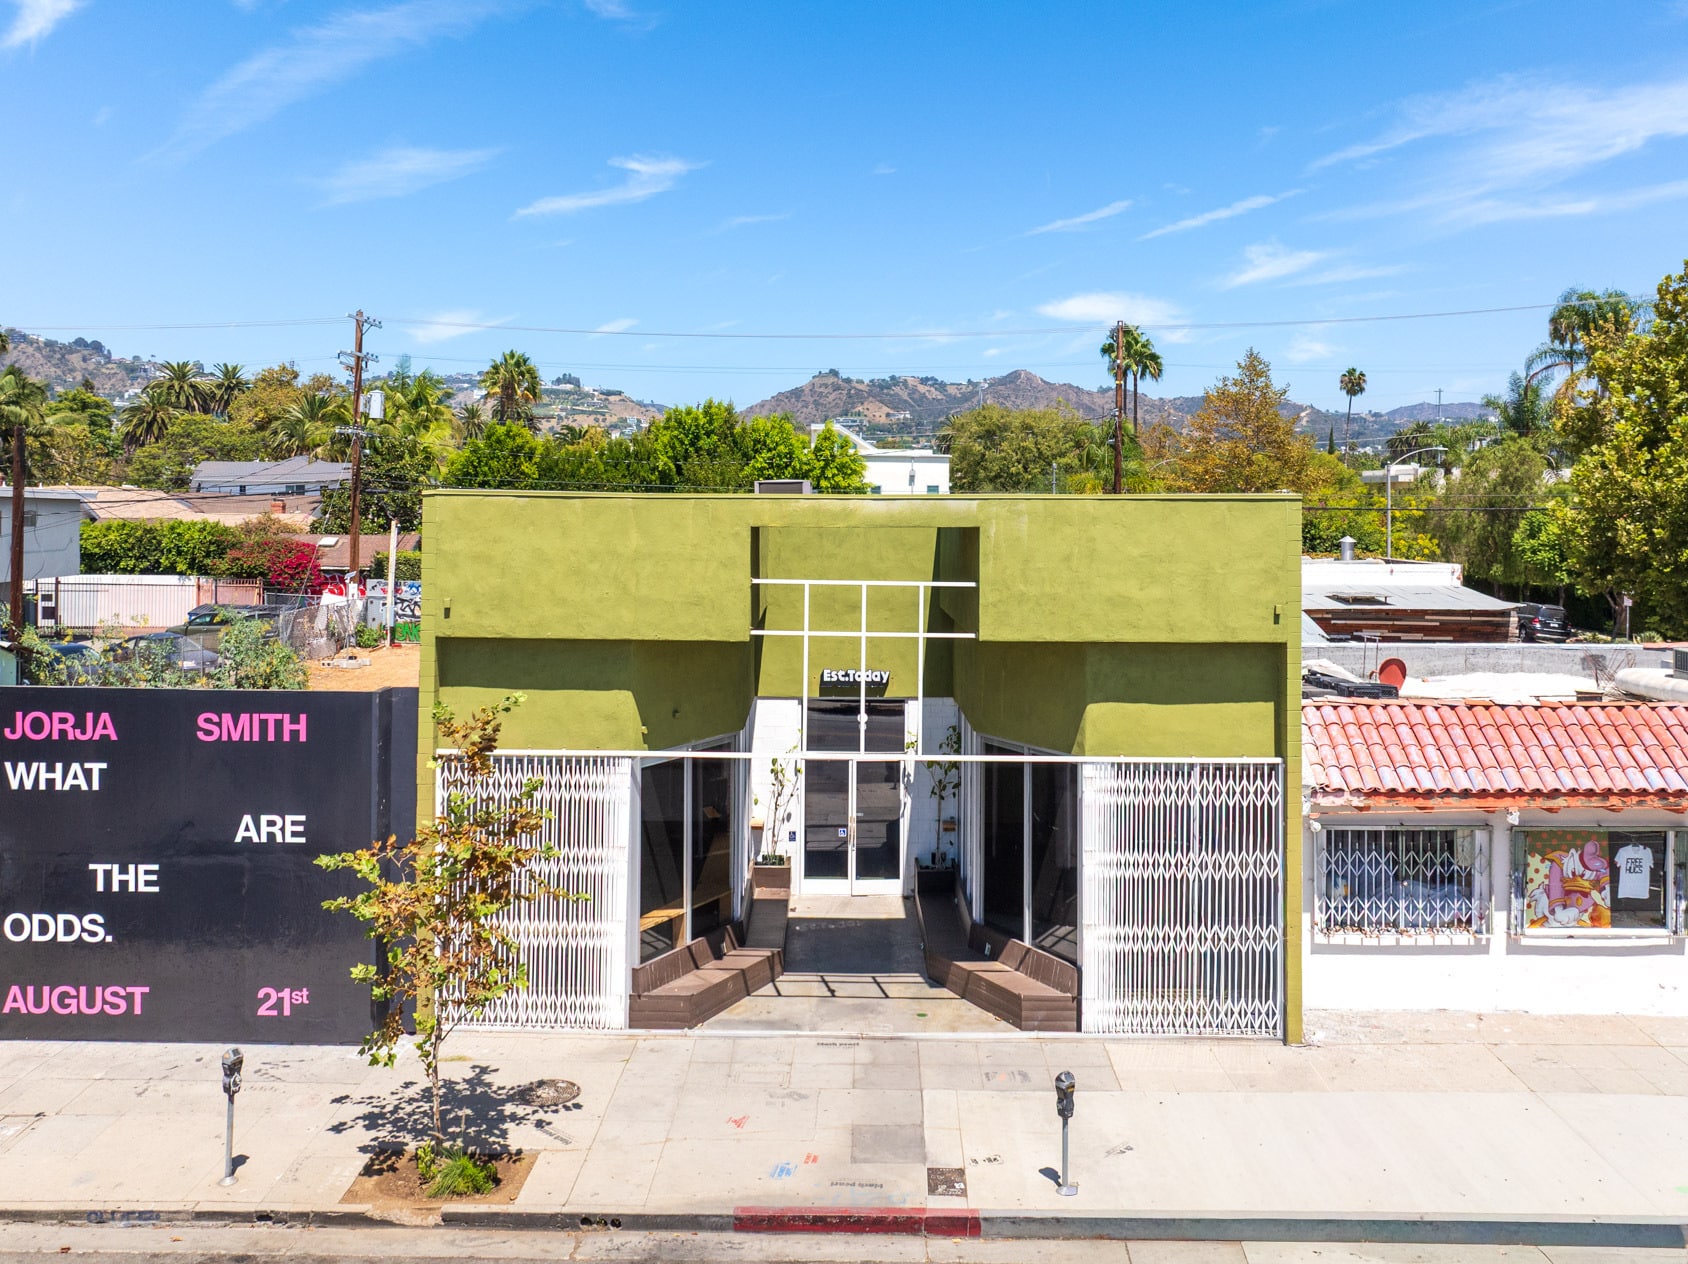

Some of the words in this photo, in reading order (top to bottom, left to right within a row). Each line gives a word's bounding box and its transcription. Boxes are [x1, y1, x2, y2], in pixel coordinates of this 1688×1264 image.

[823, 669, 890, 683] Est.Today
[4, 711, 118, 741] JORJA
[197, 712, 307, 742] SMITH
[4, 762, 107, 791] WHAT
[234, 814, 306, 843] ARE
[1626, 858, 1643, 866] FREE
[89, 864, 160, 893] THE
[4, 913, 113, 942] ODDS.
[2, 985, 150, 1016] AUGUST
[257, 987, 309, 1016] 21st
